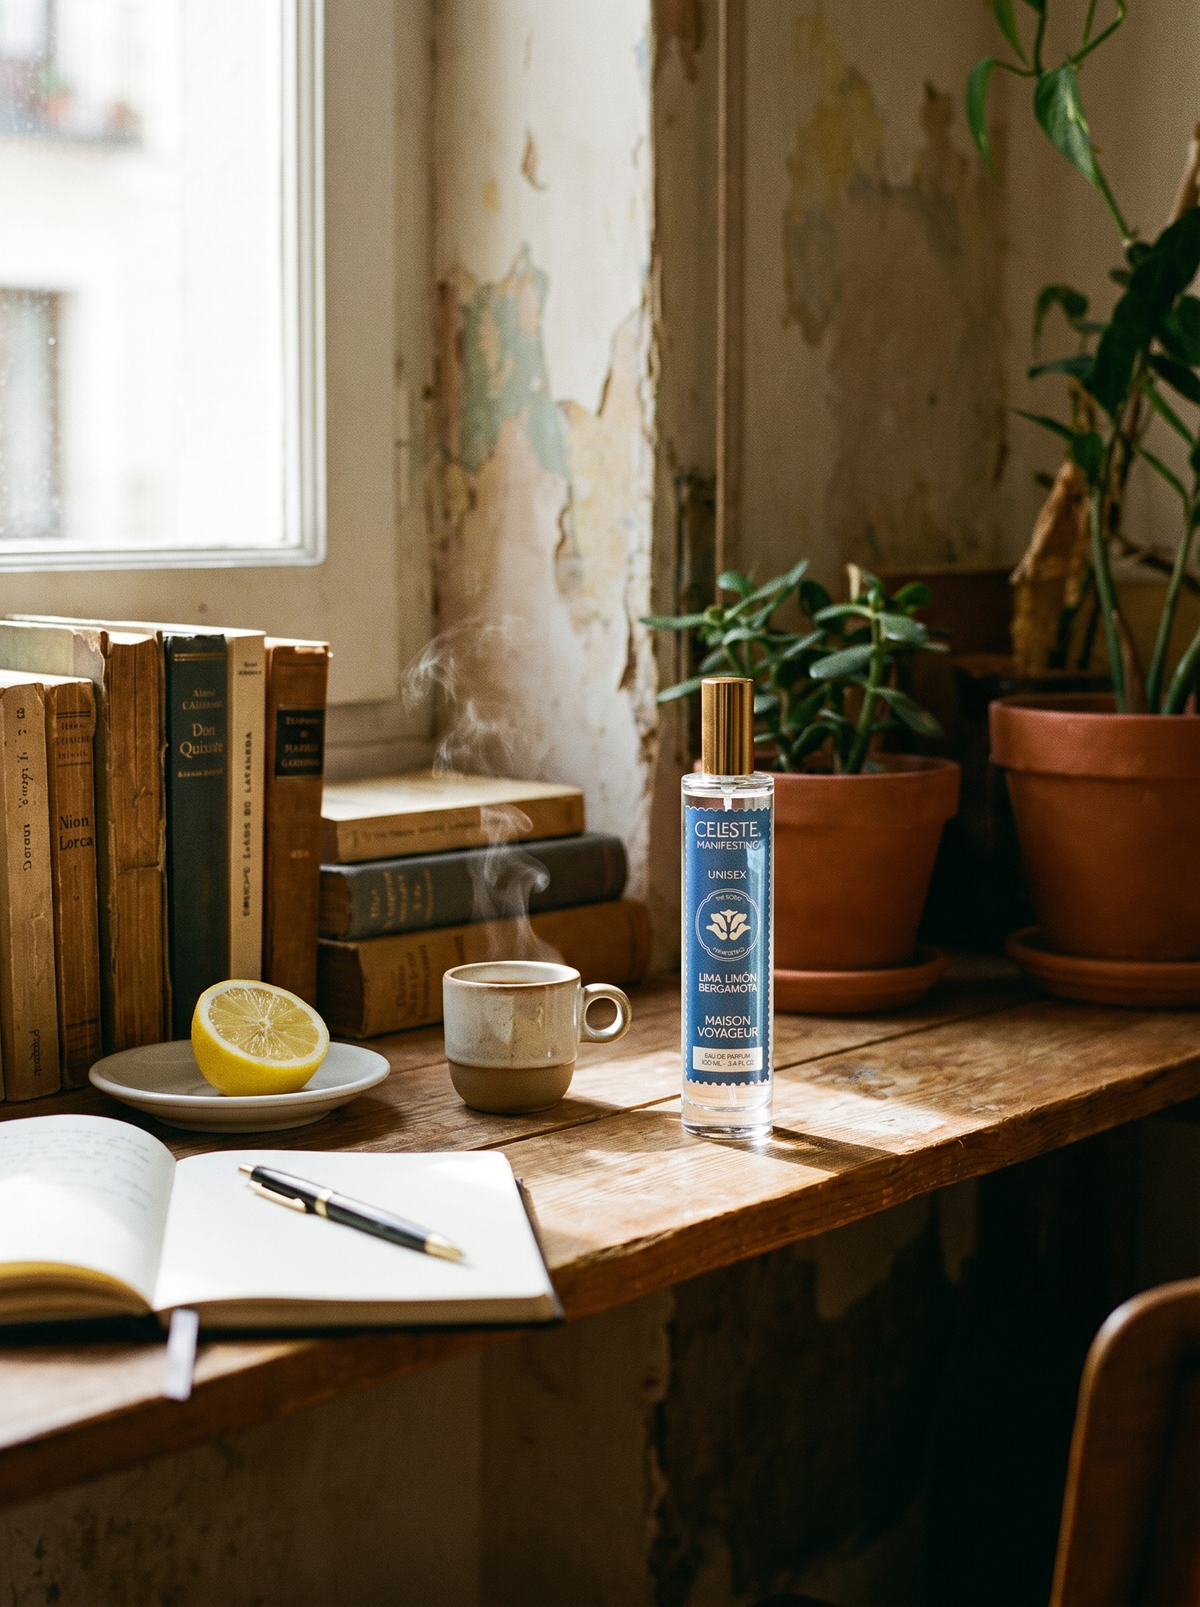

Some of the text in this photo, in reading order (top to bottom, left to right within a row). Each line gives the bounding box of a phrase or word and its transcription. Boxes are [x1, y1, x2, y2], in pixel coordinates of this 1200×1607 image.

[192, 723, 215, 737] Don
[60, 814, 89, 830] Nion
[695, 821, 758, 838] CELESTE
[60, 836, 93, 851] Lorca
[696, 840, 760, 850] MANIFESTING
[708, 870, 747, 880] UNISEX
[698, 971, 757, 983] LIMA LIMÓN
[698, 983, 758, 993] BERGAMOTA
[705, 1015, 751, 1027] MAISON
[697, 1026, 758, 1038] VOYAGEUR
[704, 1052, 716, 1060] EAU
